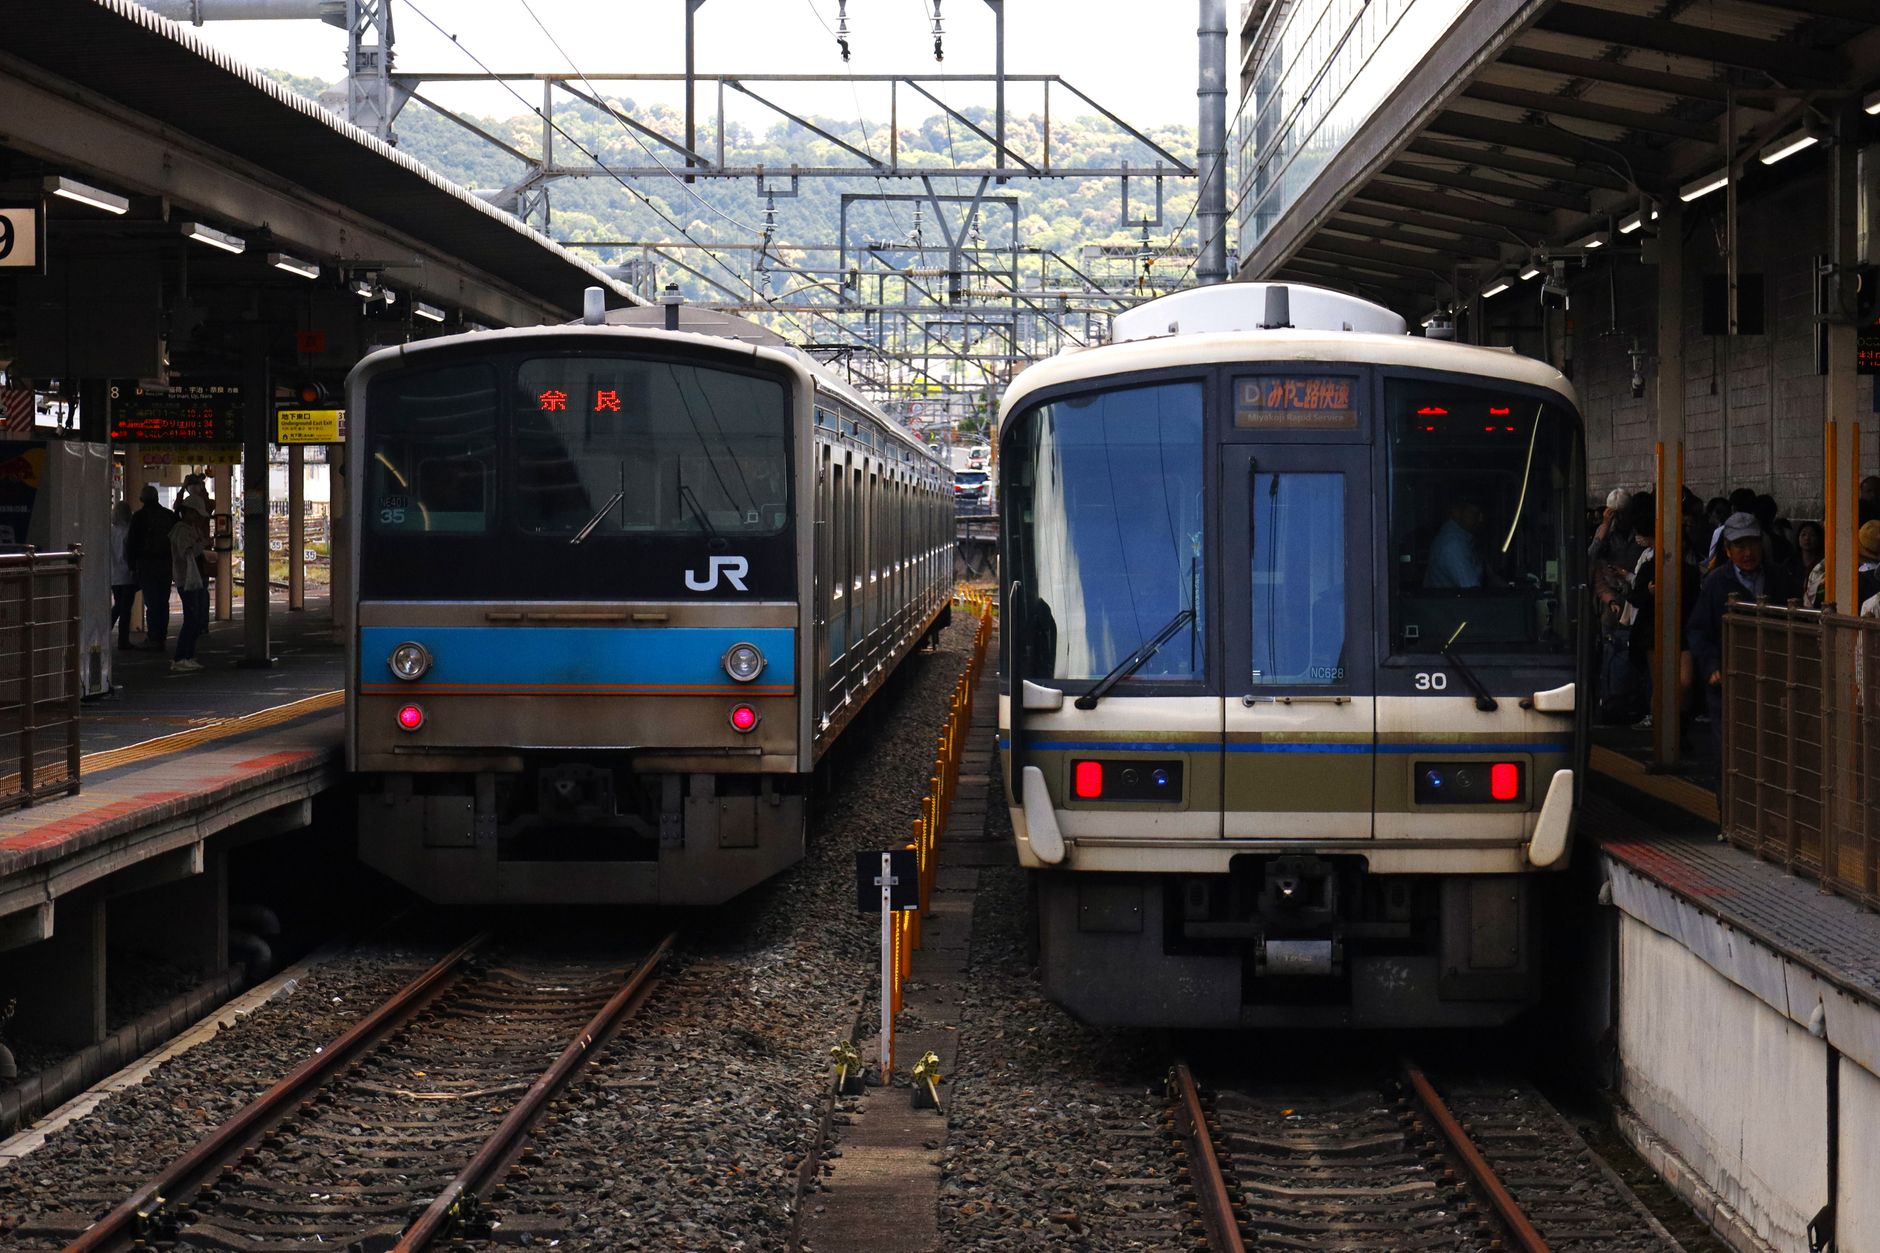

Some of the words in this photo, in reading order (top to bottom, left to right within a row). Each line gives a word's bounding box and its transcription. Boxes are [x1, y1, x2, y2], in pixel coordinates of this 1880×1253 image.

[111, 386, 119, 399] 8
[1244, 384, 1260, 403] D
[1247, 413, 1285, 423] Miyakoji
[1286, 413, 1312, 423] Rapid
[1313, 413, 1345, 422] Service
[380, 508, 405, 524] 35
[305, 550, 316, 560] 35
[684, 555, 749, 592] JR
[1310, 666, 1345, 680] NC628
[1414, 672, 1448, 691] 30
